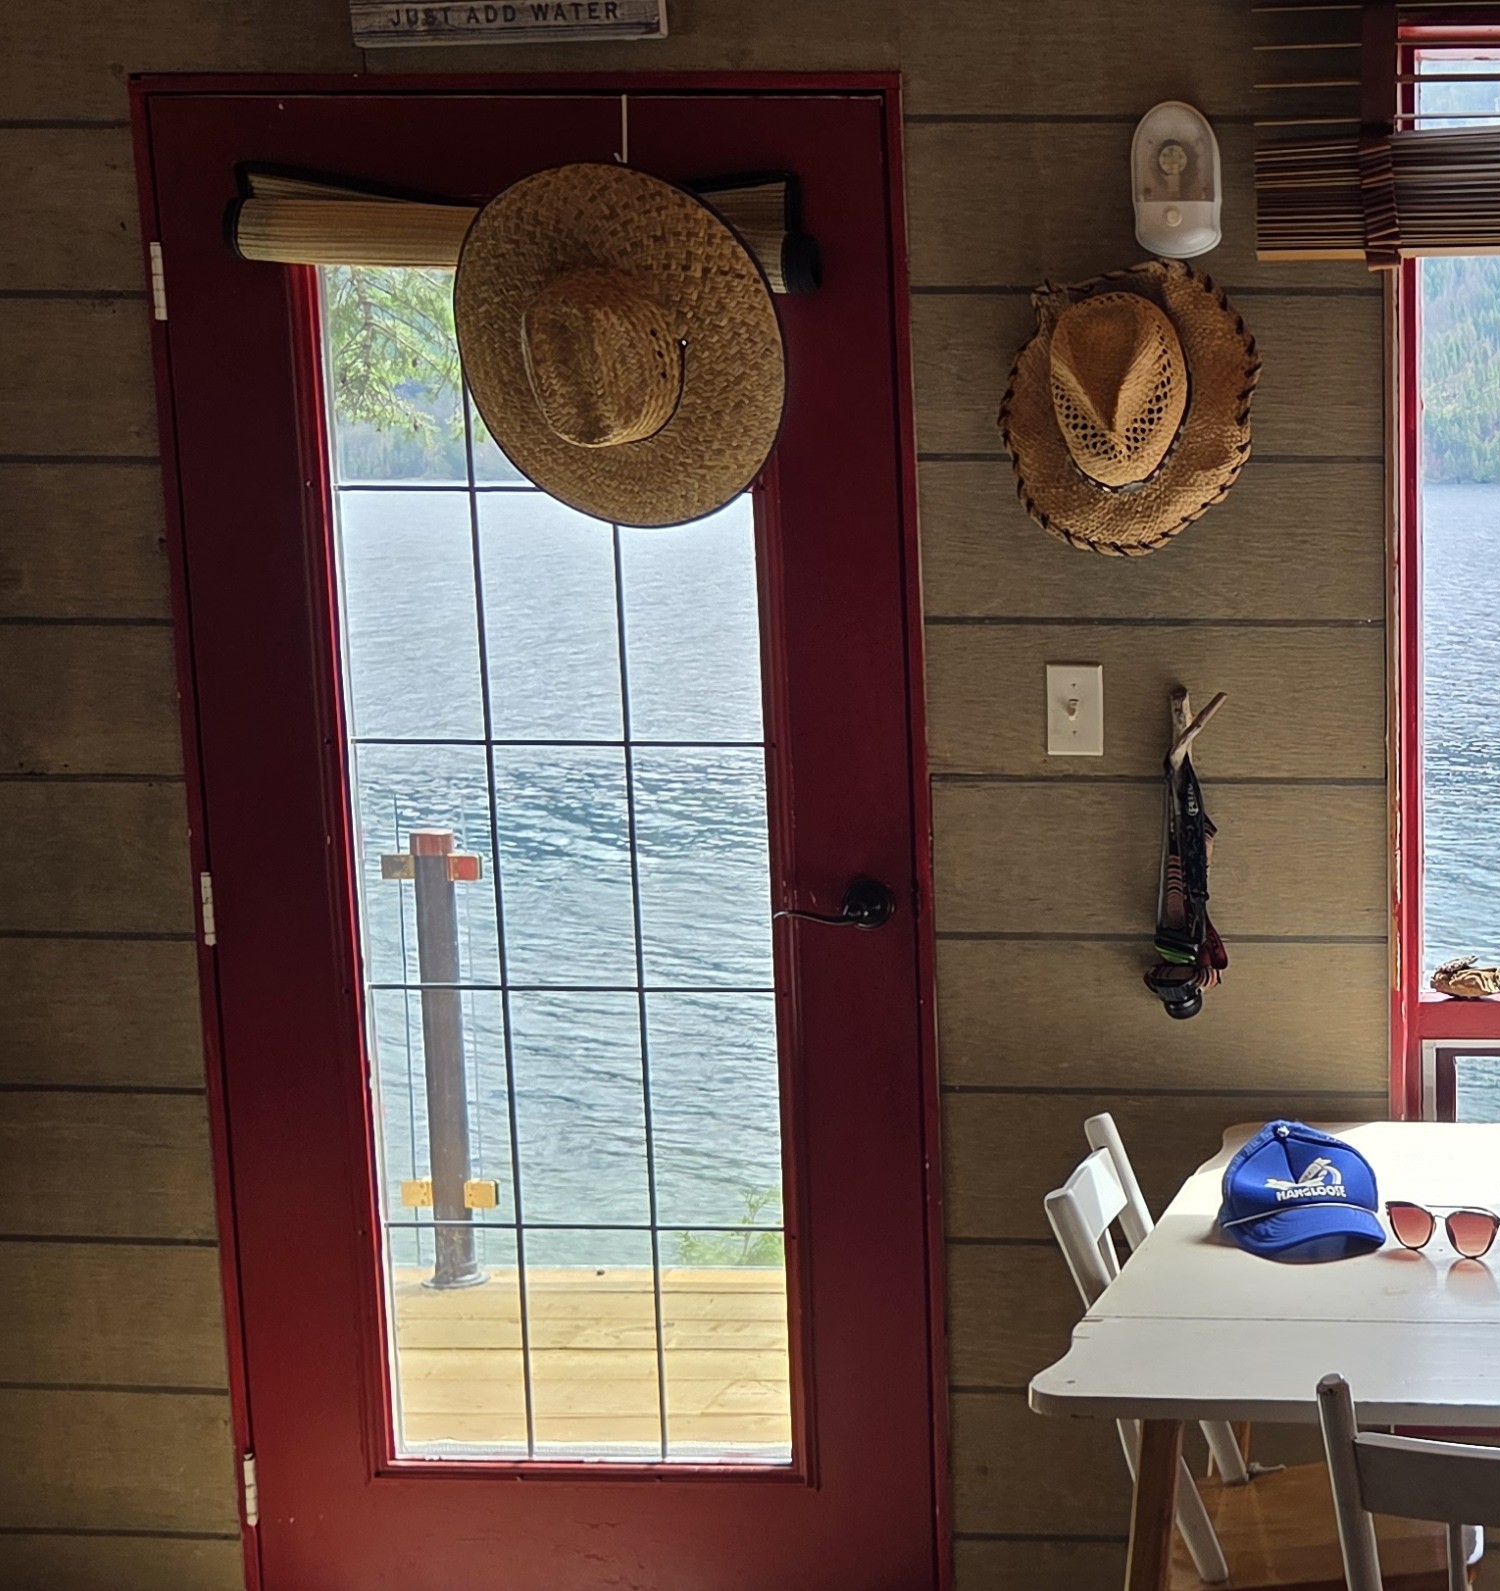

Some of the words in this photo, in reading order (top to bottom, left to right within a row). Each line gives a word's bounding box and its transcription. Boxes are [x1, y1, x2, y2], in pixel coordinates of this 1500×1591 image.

[390, 6, 452, 27] JUST
[466, 4, 517, 24] ADD
[531, 1, 619, 21] WATER
